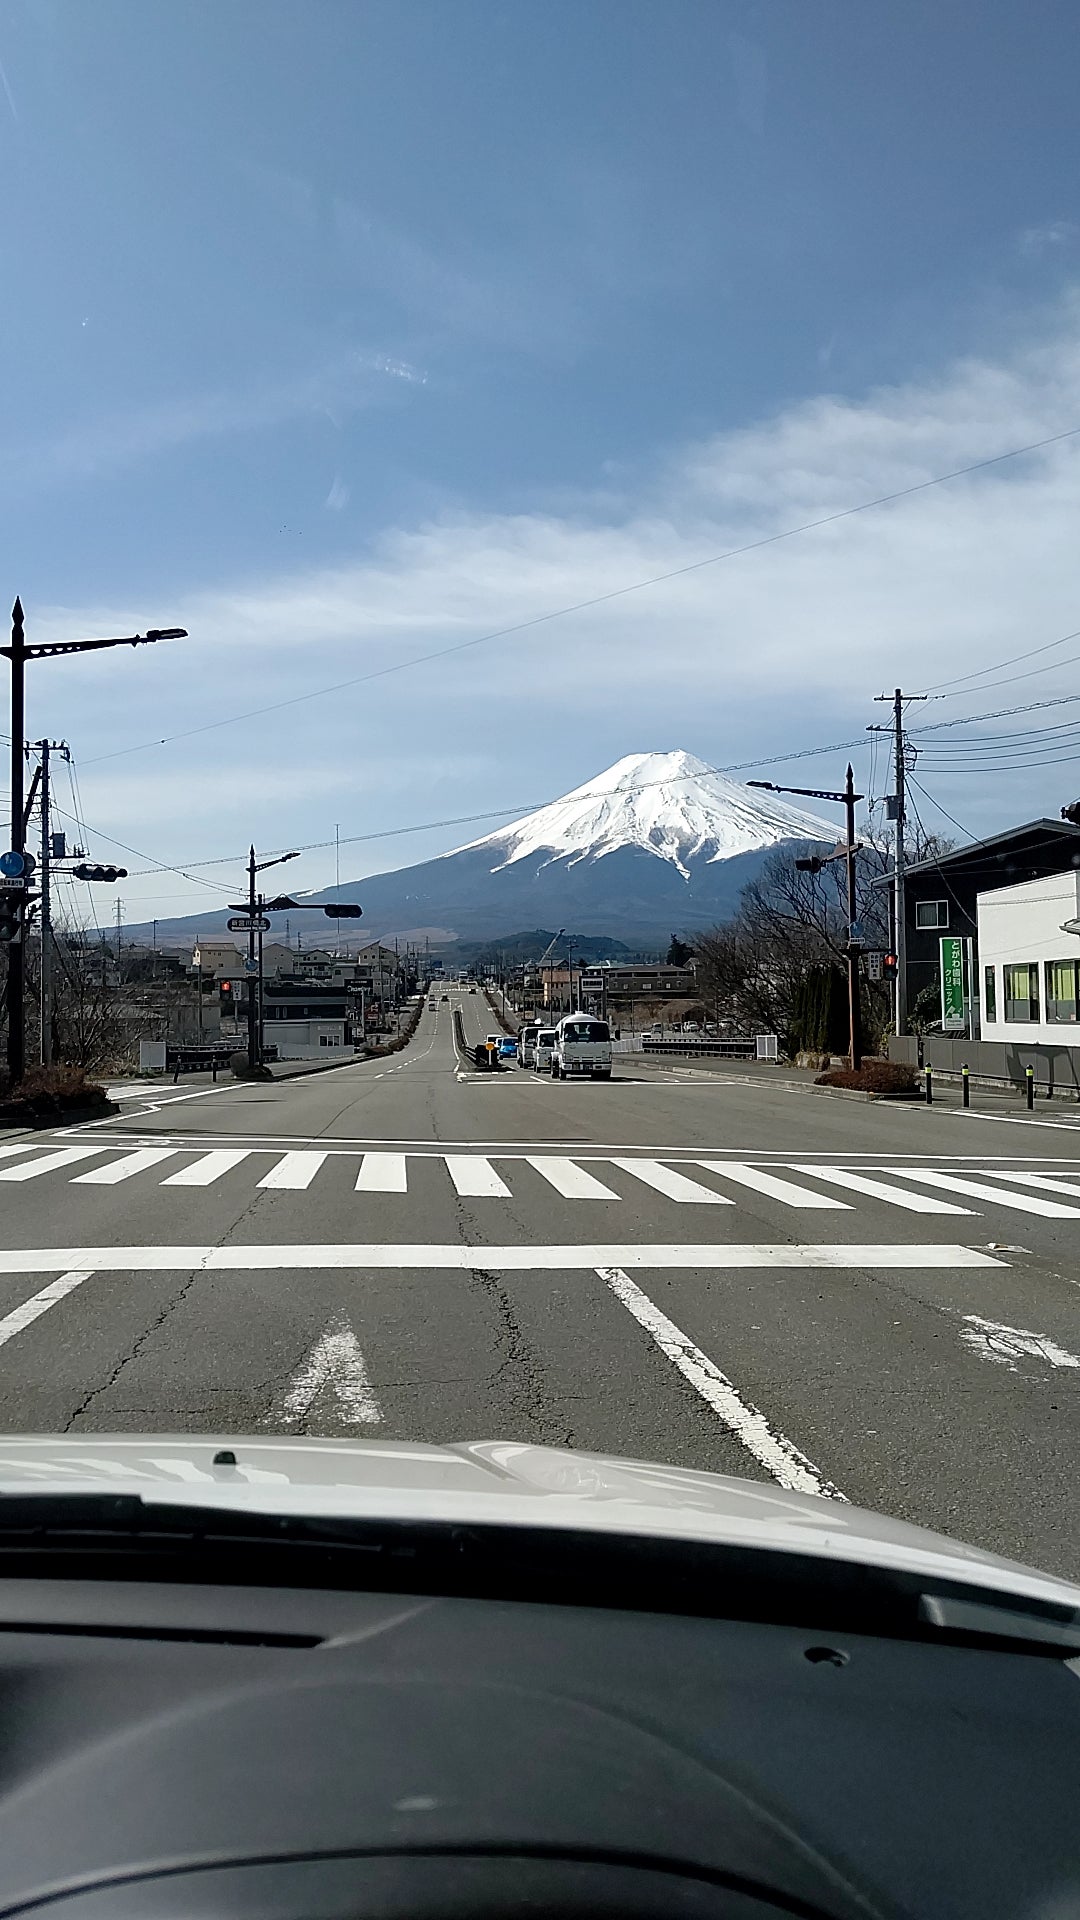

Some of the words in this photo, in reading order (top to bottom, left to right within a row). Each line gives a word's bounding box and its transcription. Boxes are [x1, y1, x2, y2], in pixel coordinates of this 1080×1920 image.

[951, 941, 961, 986] とがわ歯科
[945, 969, 953, 1004] クリニック
